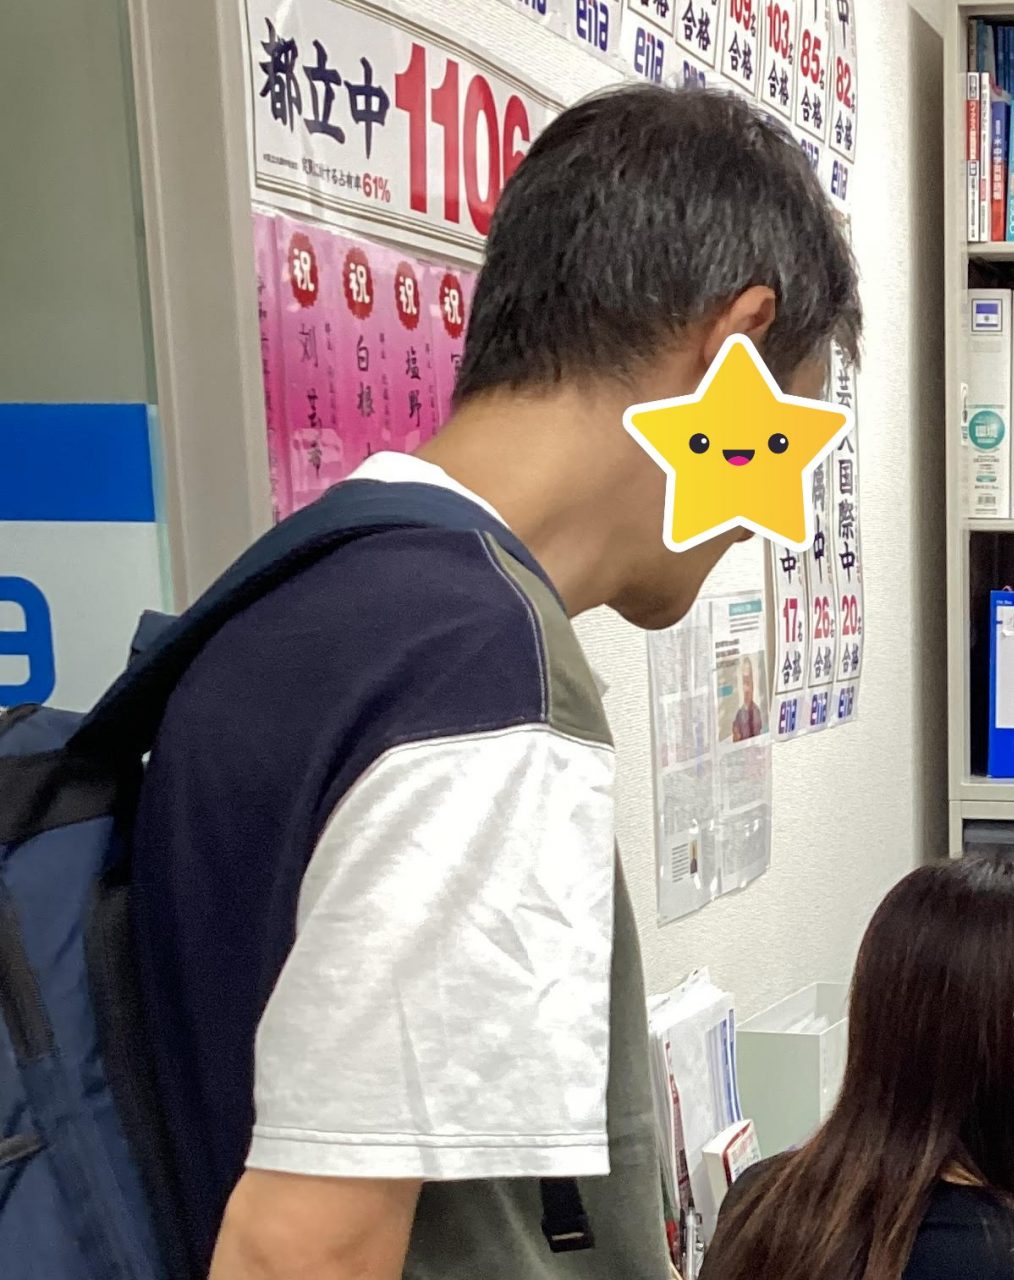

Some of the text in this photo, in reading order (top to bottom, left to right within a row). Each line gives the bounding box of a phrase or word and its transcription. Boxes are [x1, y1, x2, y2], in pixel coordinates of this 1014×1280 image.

[682, 0, 711, 51] 合格
[634, 27, 664, 82] ena
[728, 31, 753, 80] 合格
[259, 17, 390, 160] 都立中
[768, 59, 790, 106] 合格
[801, 86, 823, 129] 合格
[834, 111, 853, 150] 合格
[362, 173, 391, 203] 61%
[831, 160, 848, 200] ena
[293, 248, 315, 293] 祝
[349, 262, 370, 303] 祝
[399, 275, 418, 315] 祝
[444, 286, 462, 325] 祝
[781, 651, 803, 687] 合格
[813, 646, 832, 678] 合格
[841, 643, 859, 674] 合格
[778, 699, 797, 734] ena
[810, 693, 828, 727] ena
[837, 685, 854, 719] ena
